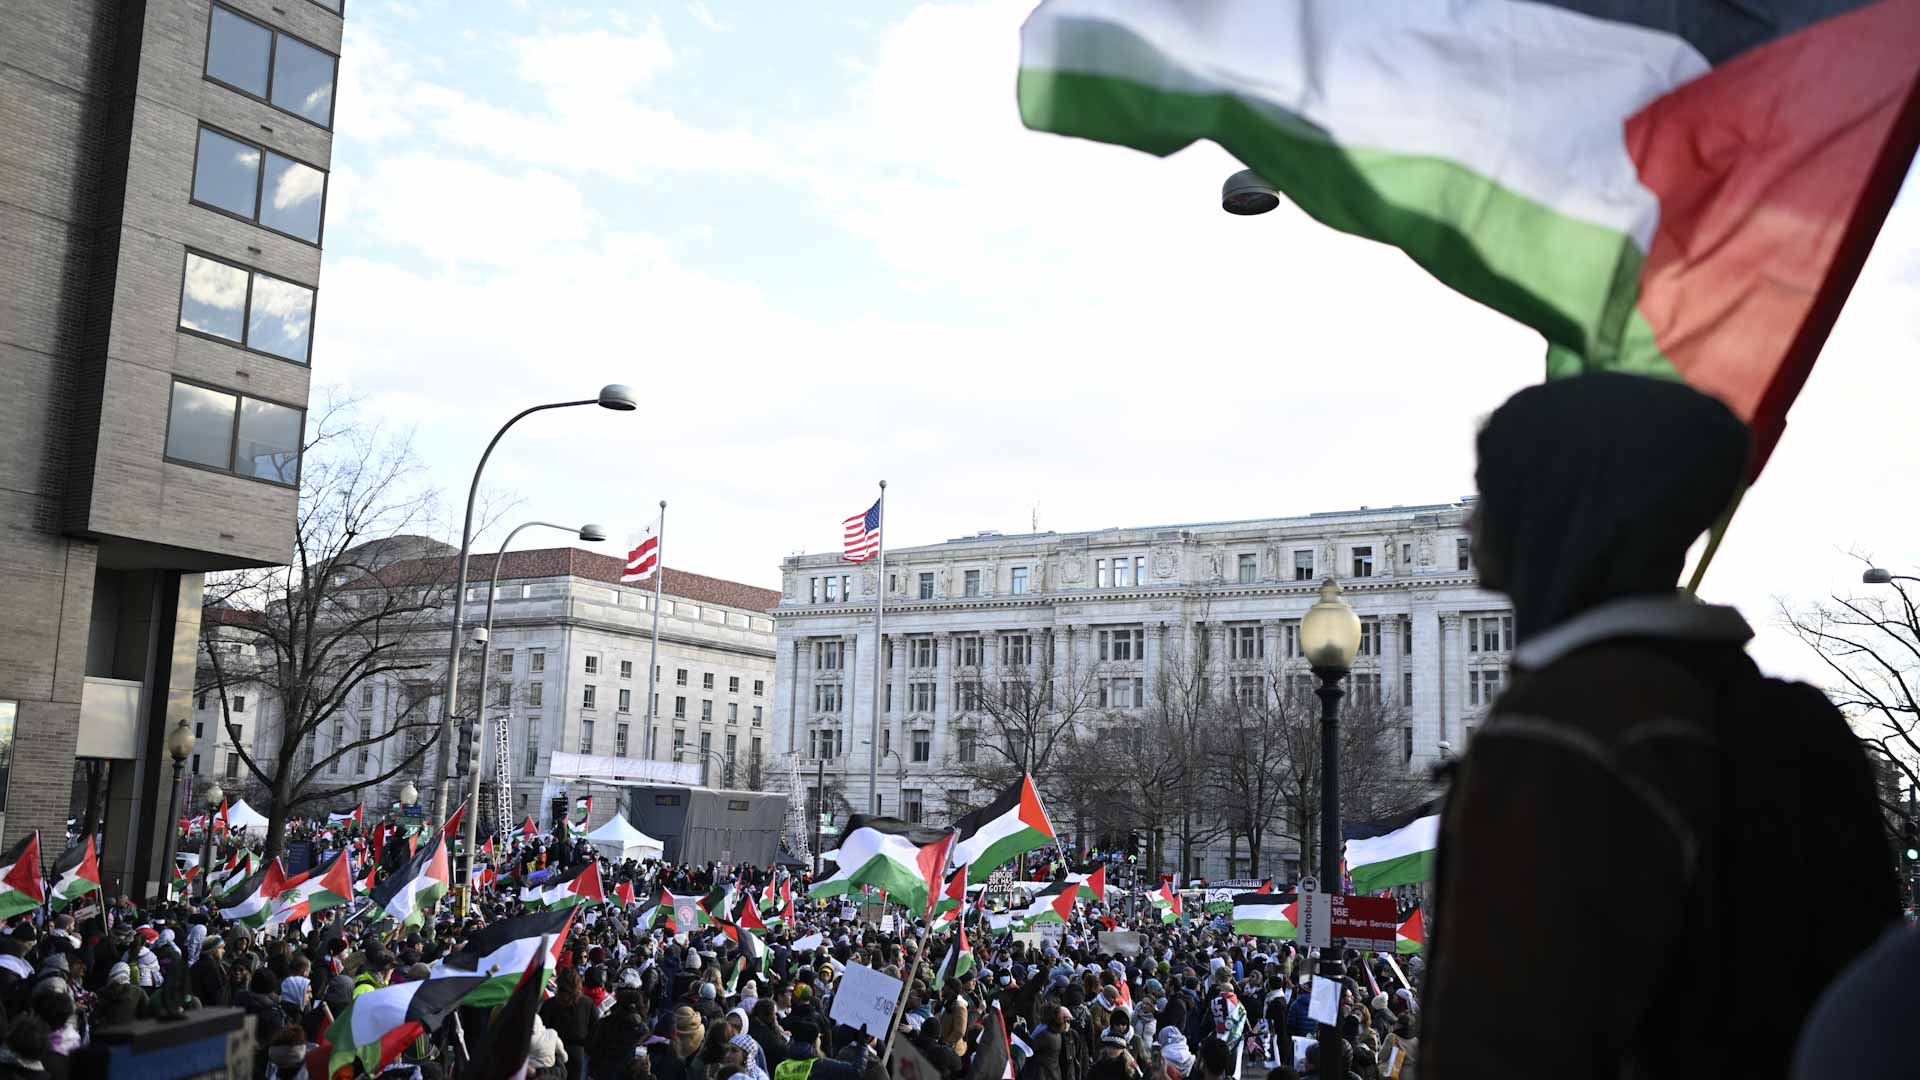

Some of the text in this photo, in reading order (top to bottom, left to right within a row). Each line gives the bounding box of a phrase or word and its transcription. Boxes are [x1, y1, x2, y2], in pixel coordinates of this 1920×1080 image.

[1332, 896, 1344, 905] 52
[1333, 907, 1349, 917] 16E
[1304, 895, 1312, 943] metrobus
[1332, 917, 1347, 925] Late
[1349, 919, 1367, 927] Night
